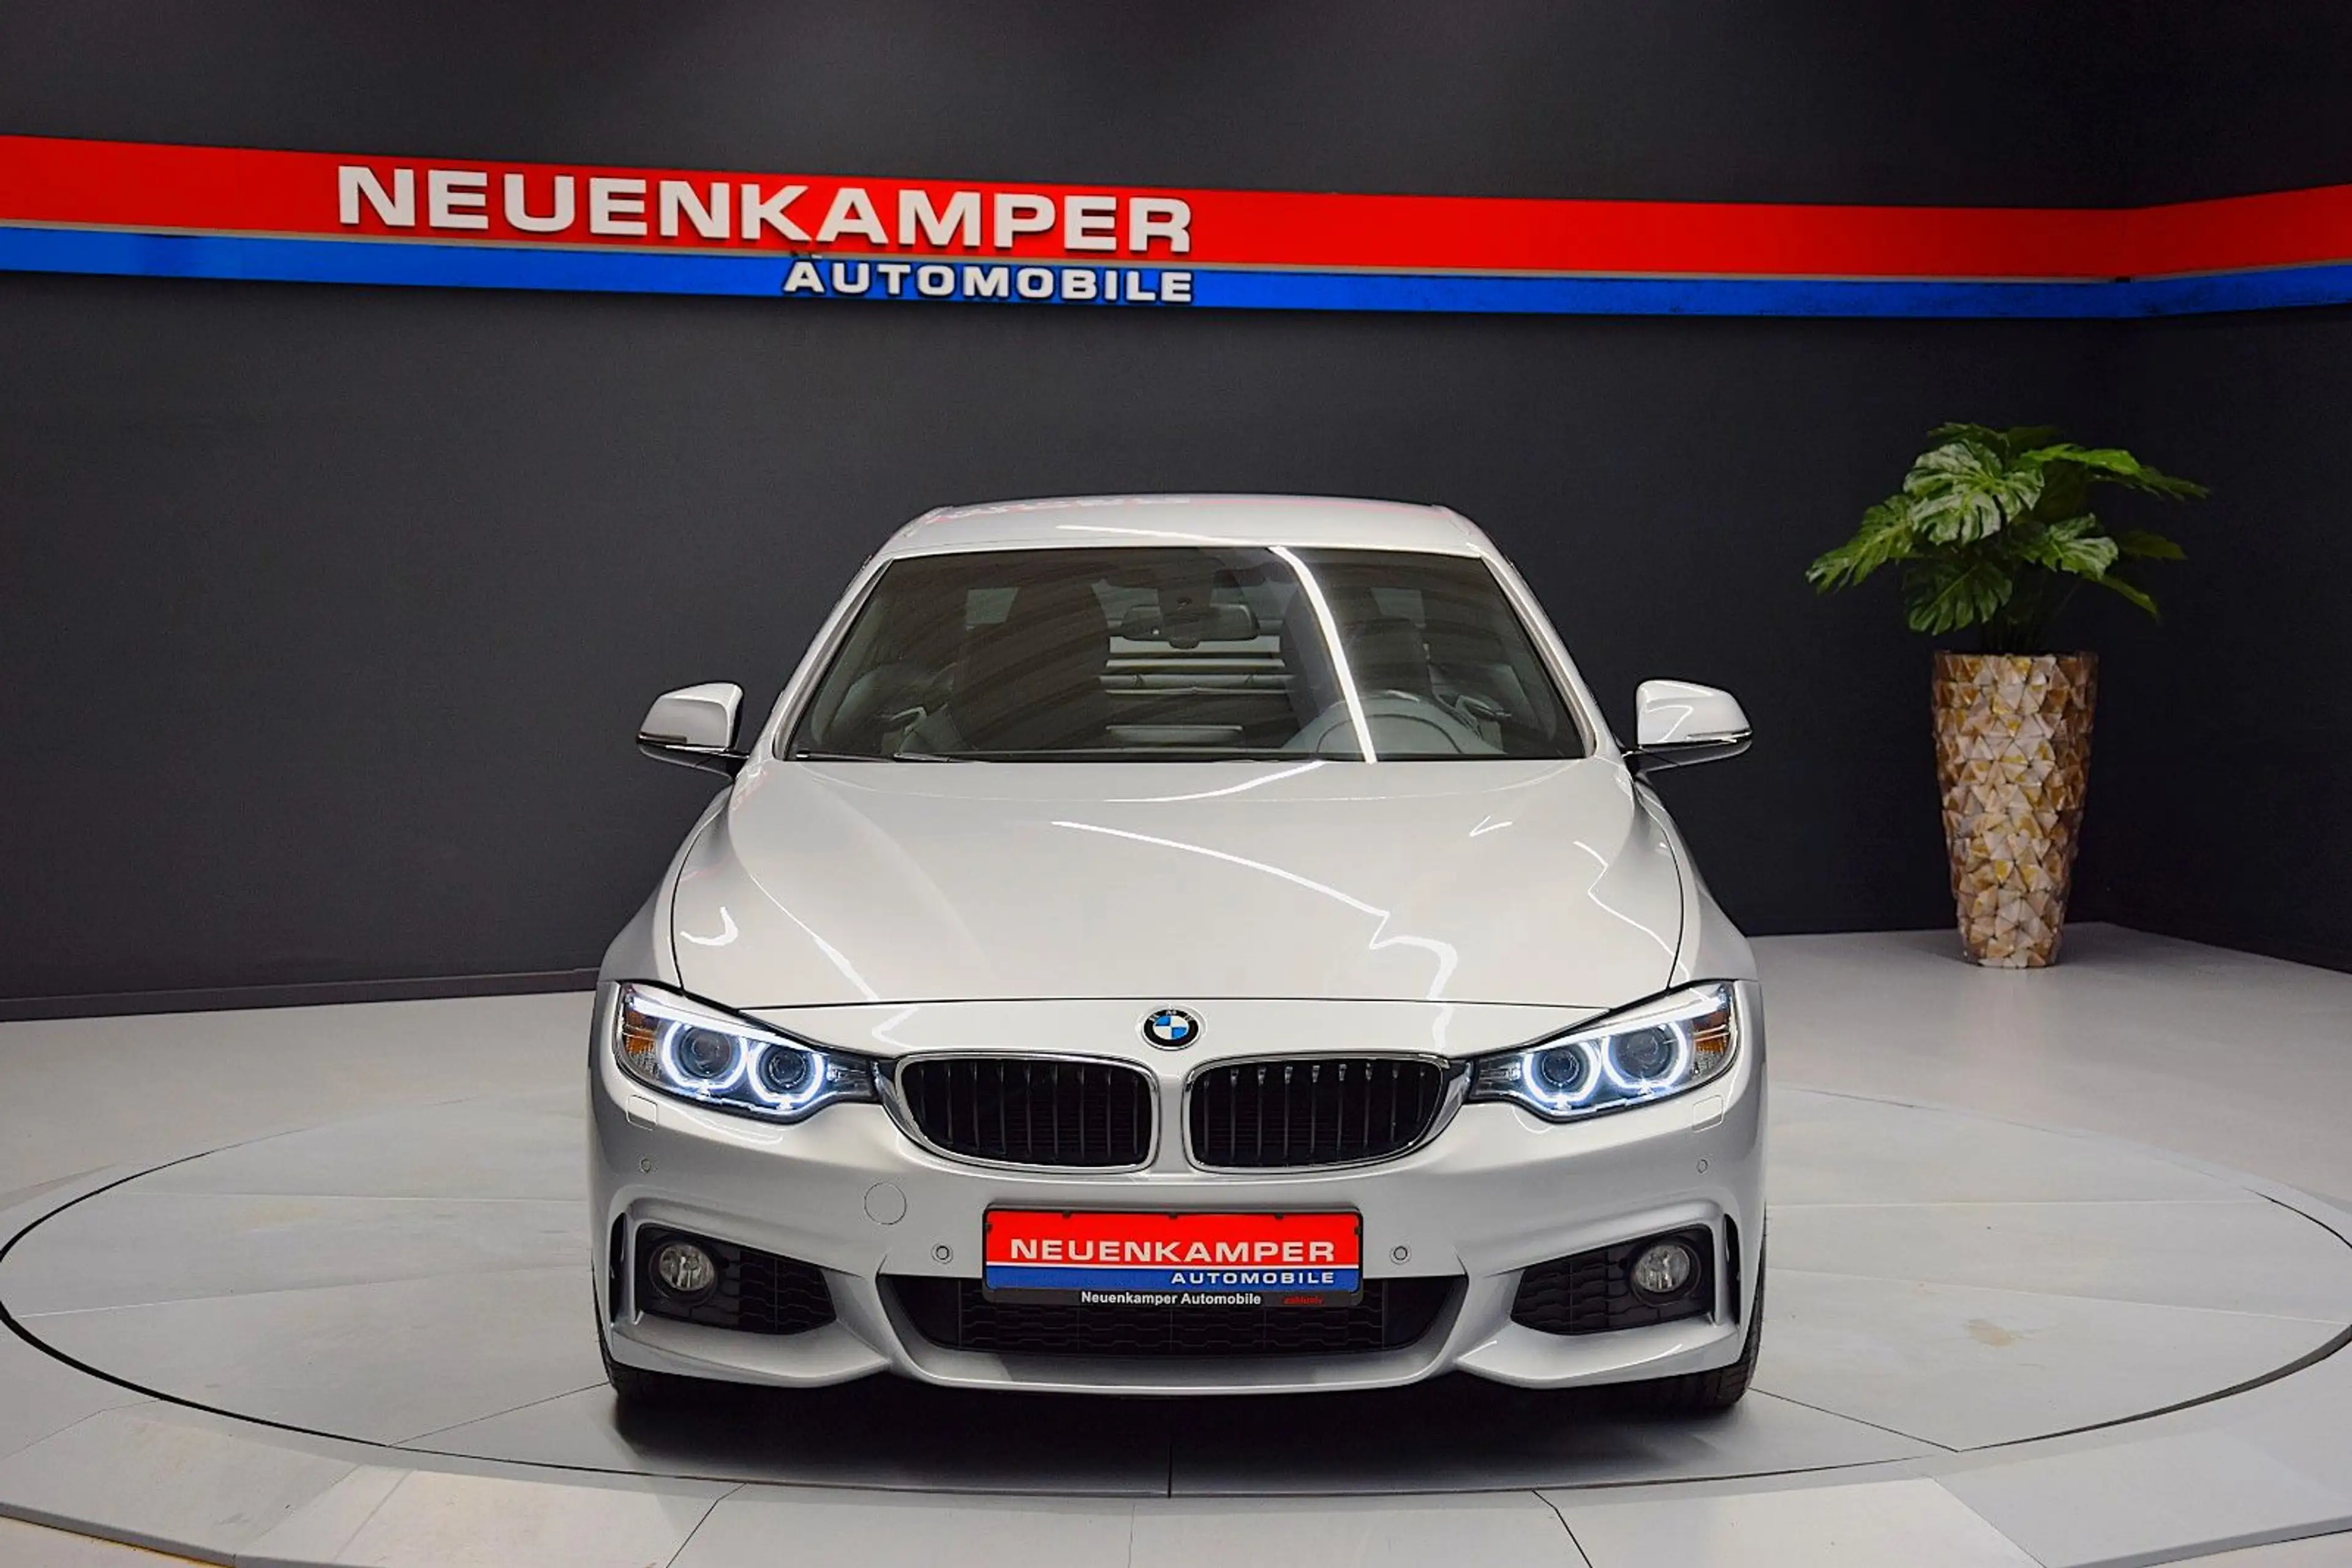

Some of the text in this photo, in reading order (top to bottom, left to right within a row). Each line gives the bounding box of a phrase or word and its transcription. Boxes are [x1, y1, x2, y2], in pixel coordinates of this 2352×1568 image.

[338, 165, 1191, 252] NEUENKAMPER
[783, 261, 1192, 302] AUTOMOBILE
[1011, 1238, 1335, 1262] NEUENKAMPER
[1170, 1272, 1335, 1284] AUTOMOBILE
[1081, 1291, 1261, 1306] Neuenkamper Automobile
